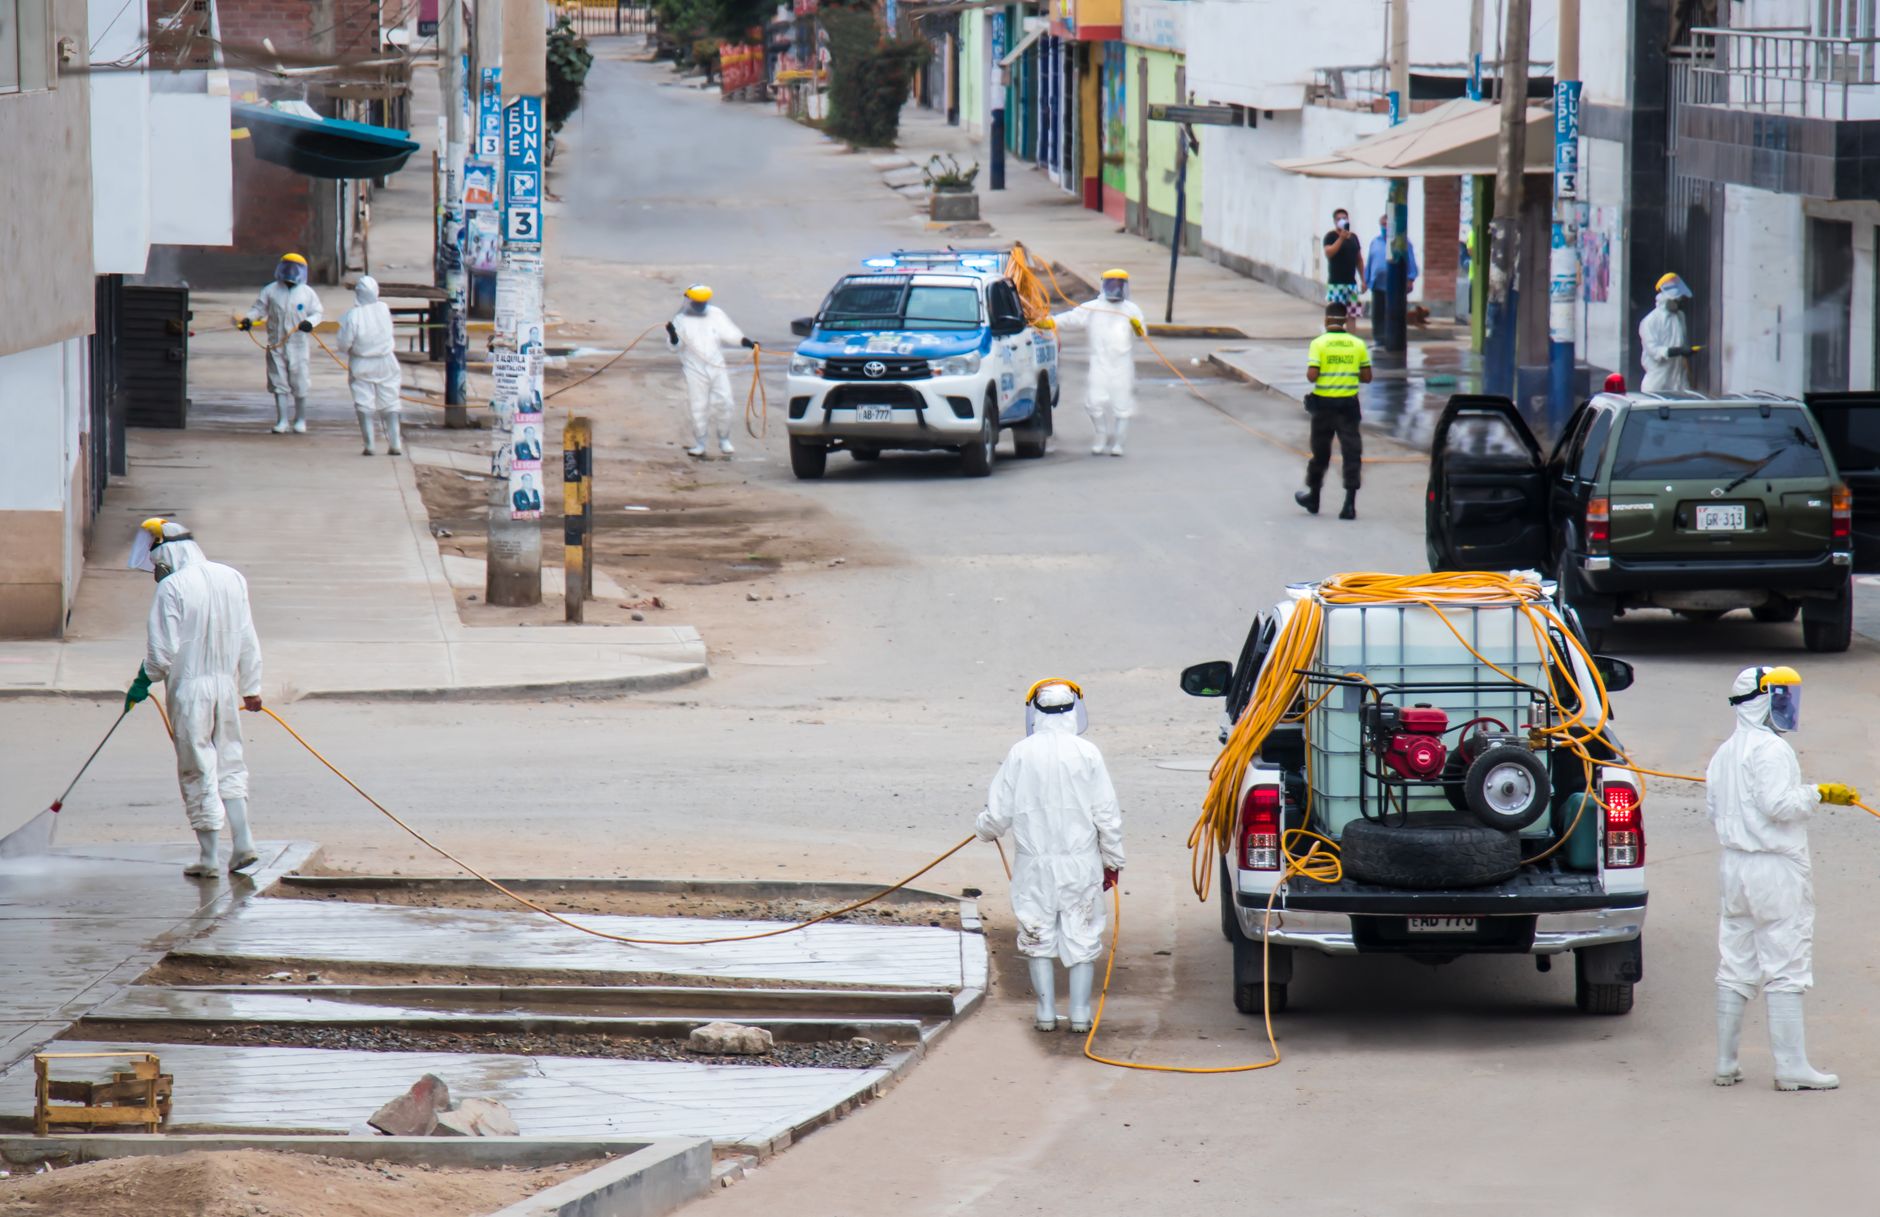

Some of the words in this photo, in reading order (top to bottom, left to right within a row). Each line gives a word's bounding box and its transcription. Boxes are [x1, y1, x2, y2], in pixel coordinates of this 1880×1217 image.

[1558, 82, 1568, 134] PEPE
[1568, 89, 1578, 140] LUNA
[487, 139, 496, 152] 3
[508, 107, 522, 156] EPE
[523, 99, 538, 165] LUNA
[1562, 175, 1575, 192] 3
[515, 212, 532, 235] 3
[1706, 512, 1742, 526] GR-313
